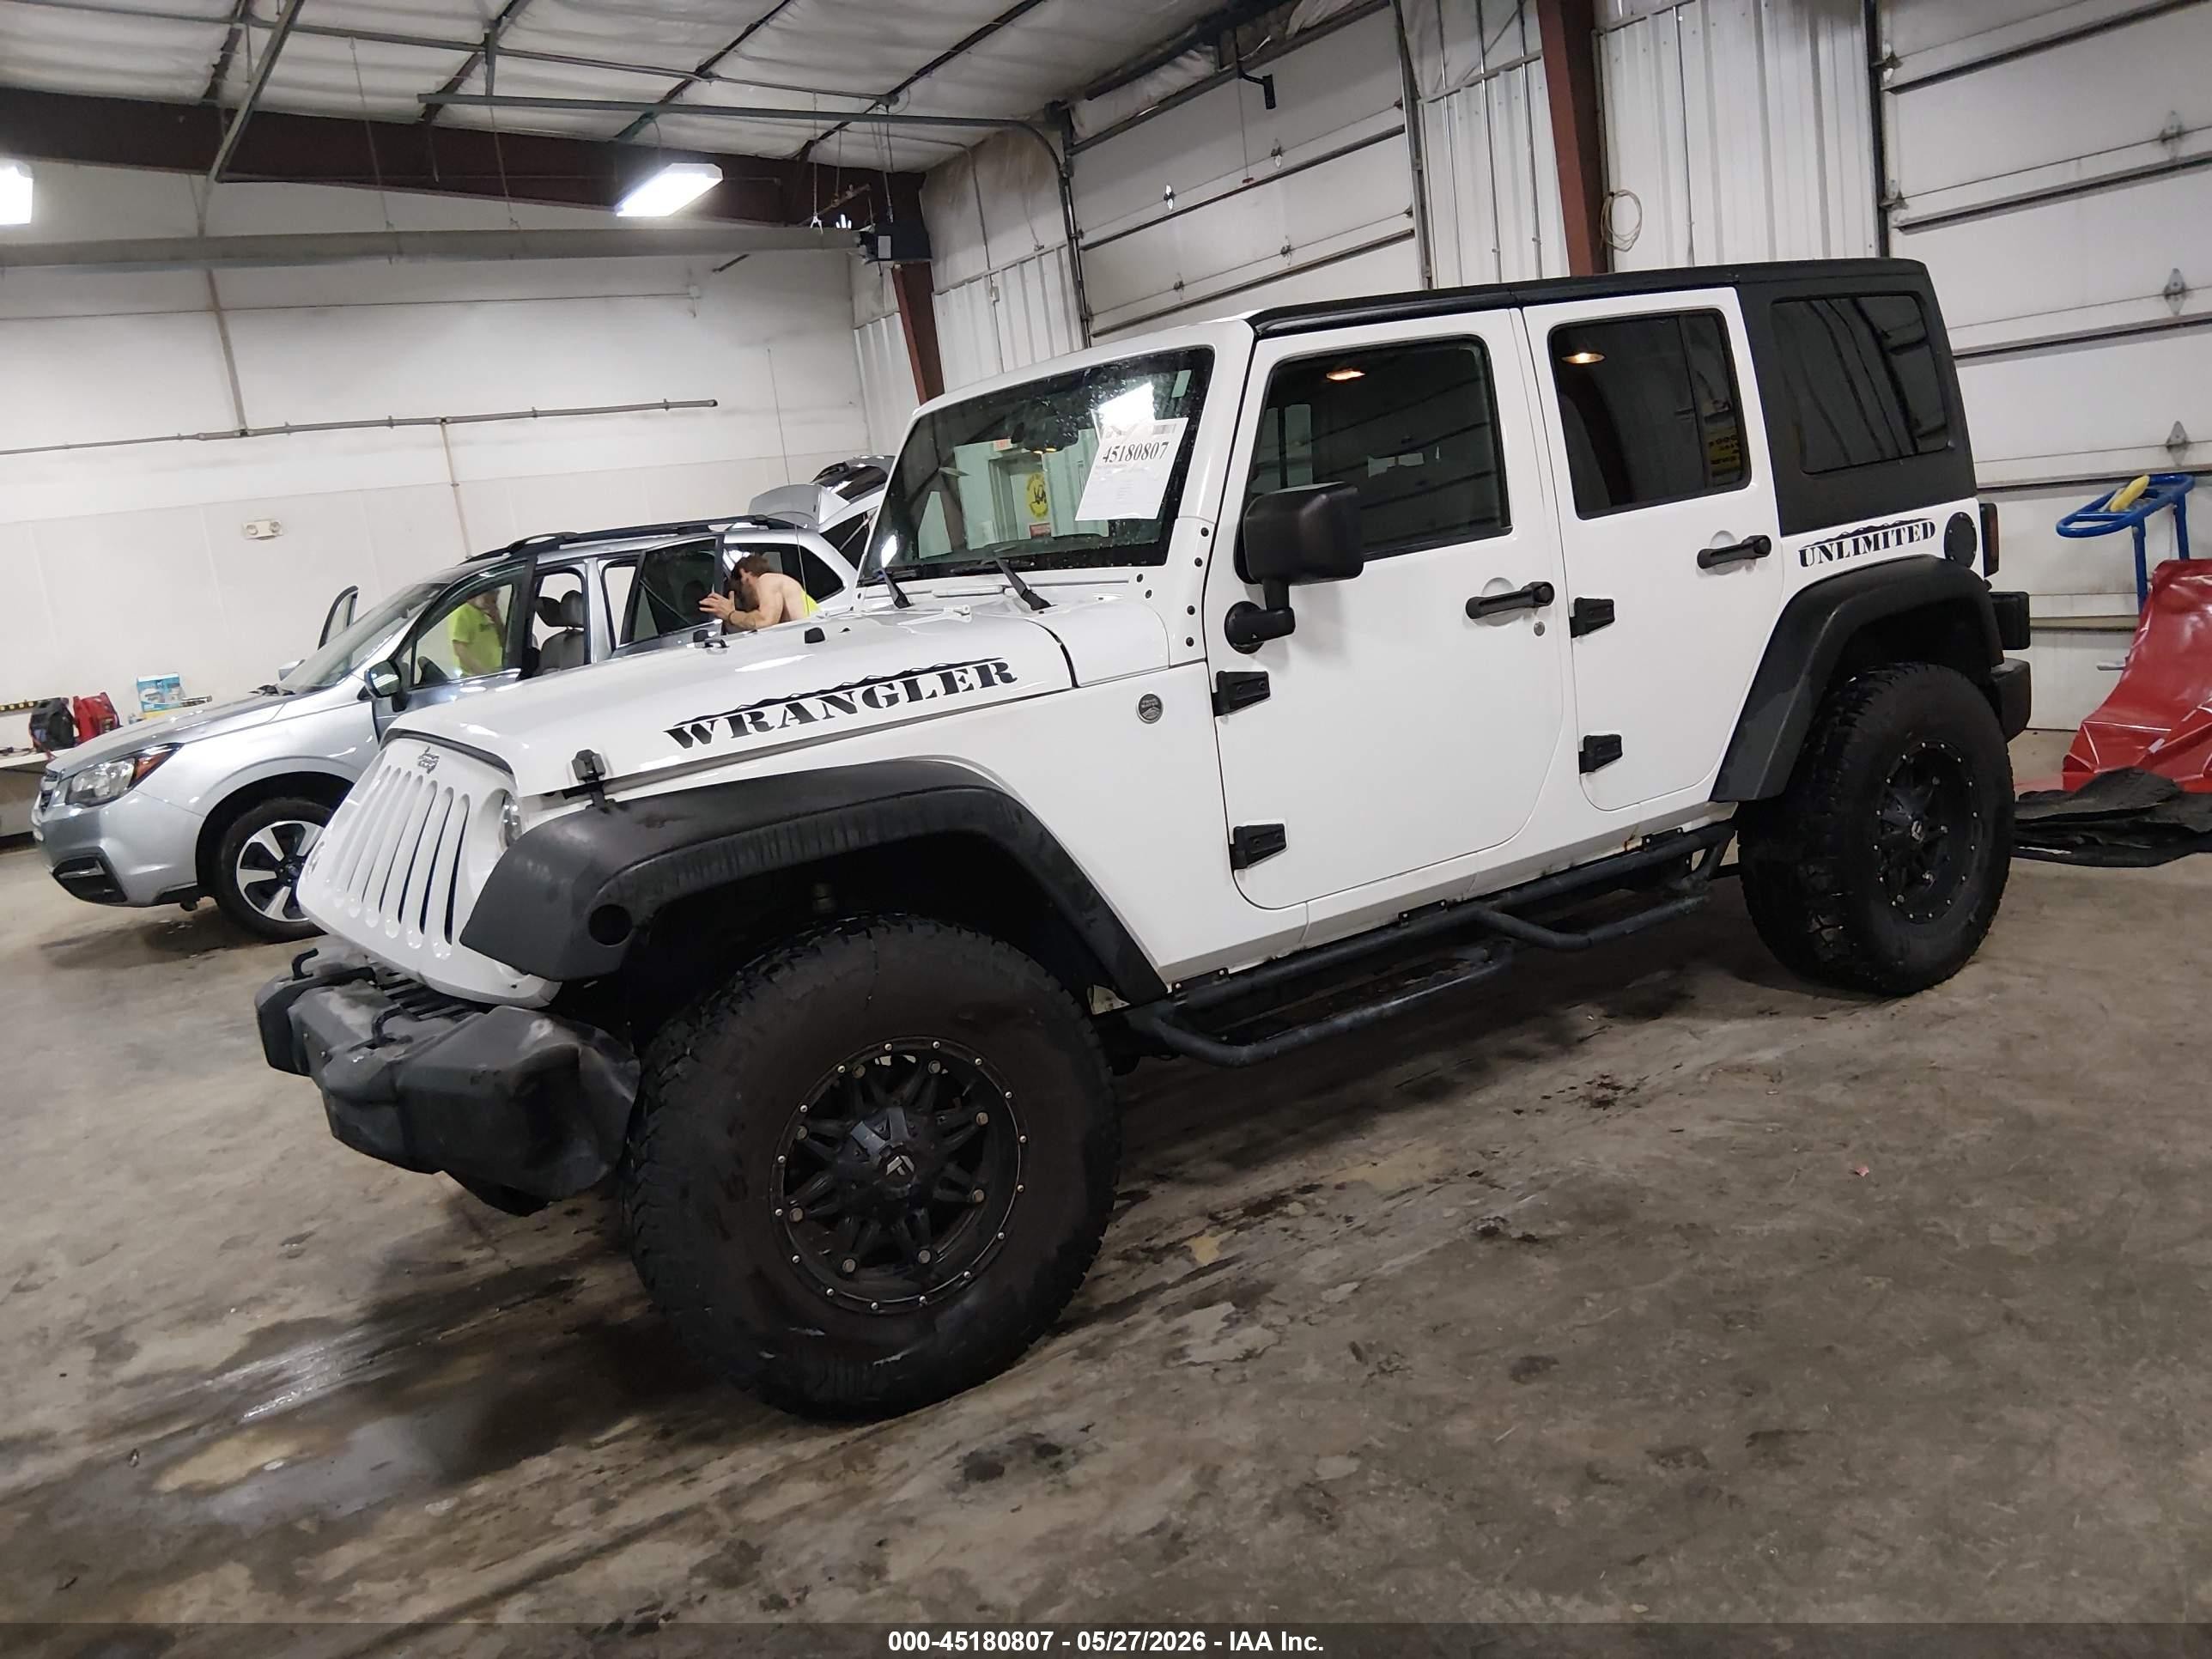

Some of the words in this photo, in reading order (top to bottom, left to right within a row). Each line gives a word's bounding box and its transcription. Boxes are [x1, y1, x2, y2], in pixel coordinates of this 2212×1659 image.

[1102, 441, 1170, 464] 45180807
[1798, 521, 1936, 568] UNLIMITED
[664, 661, 1018, 750] WRANGLER
